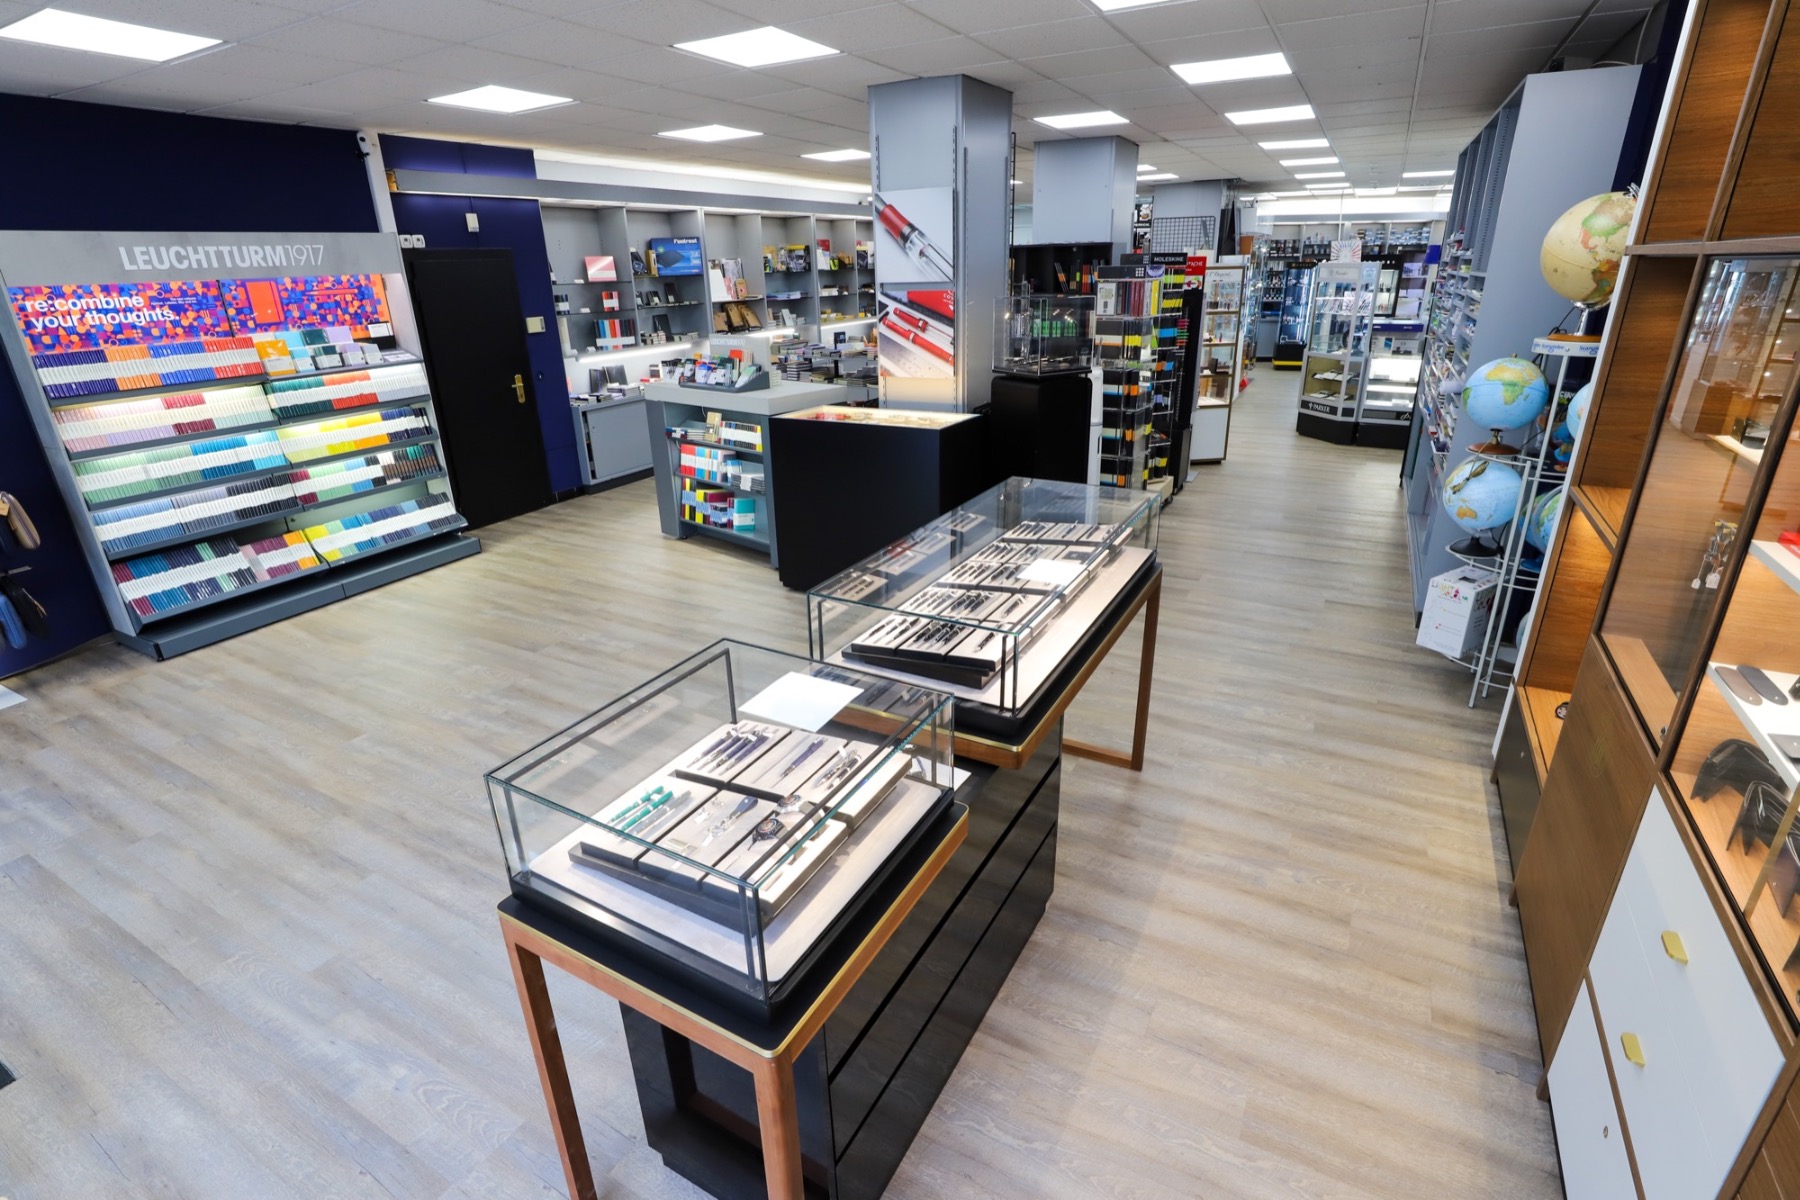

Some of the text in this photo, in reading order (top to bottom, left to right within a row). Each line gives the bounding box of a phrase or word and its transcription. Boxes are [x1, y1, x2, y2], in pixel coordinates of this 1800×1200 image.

[118, 245, 324, 271] LEUCHTTURM1917
[25, 293, 144, 312] re:combine
[31, 307, 180, 332] your thoughts.
[1313, 404, 1330, 413] PARKER
